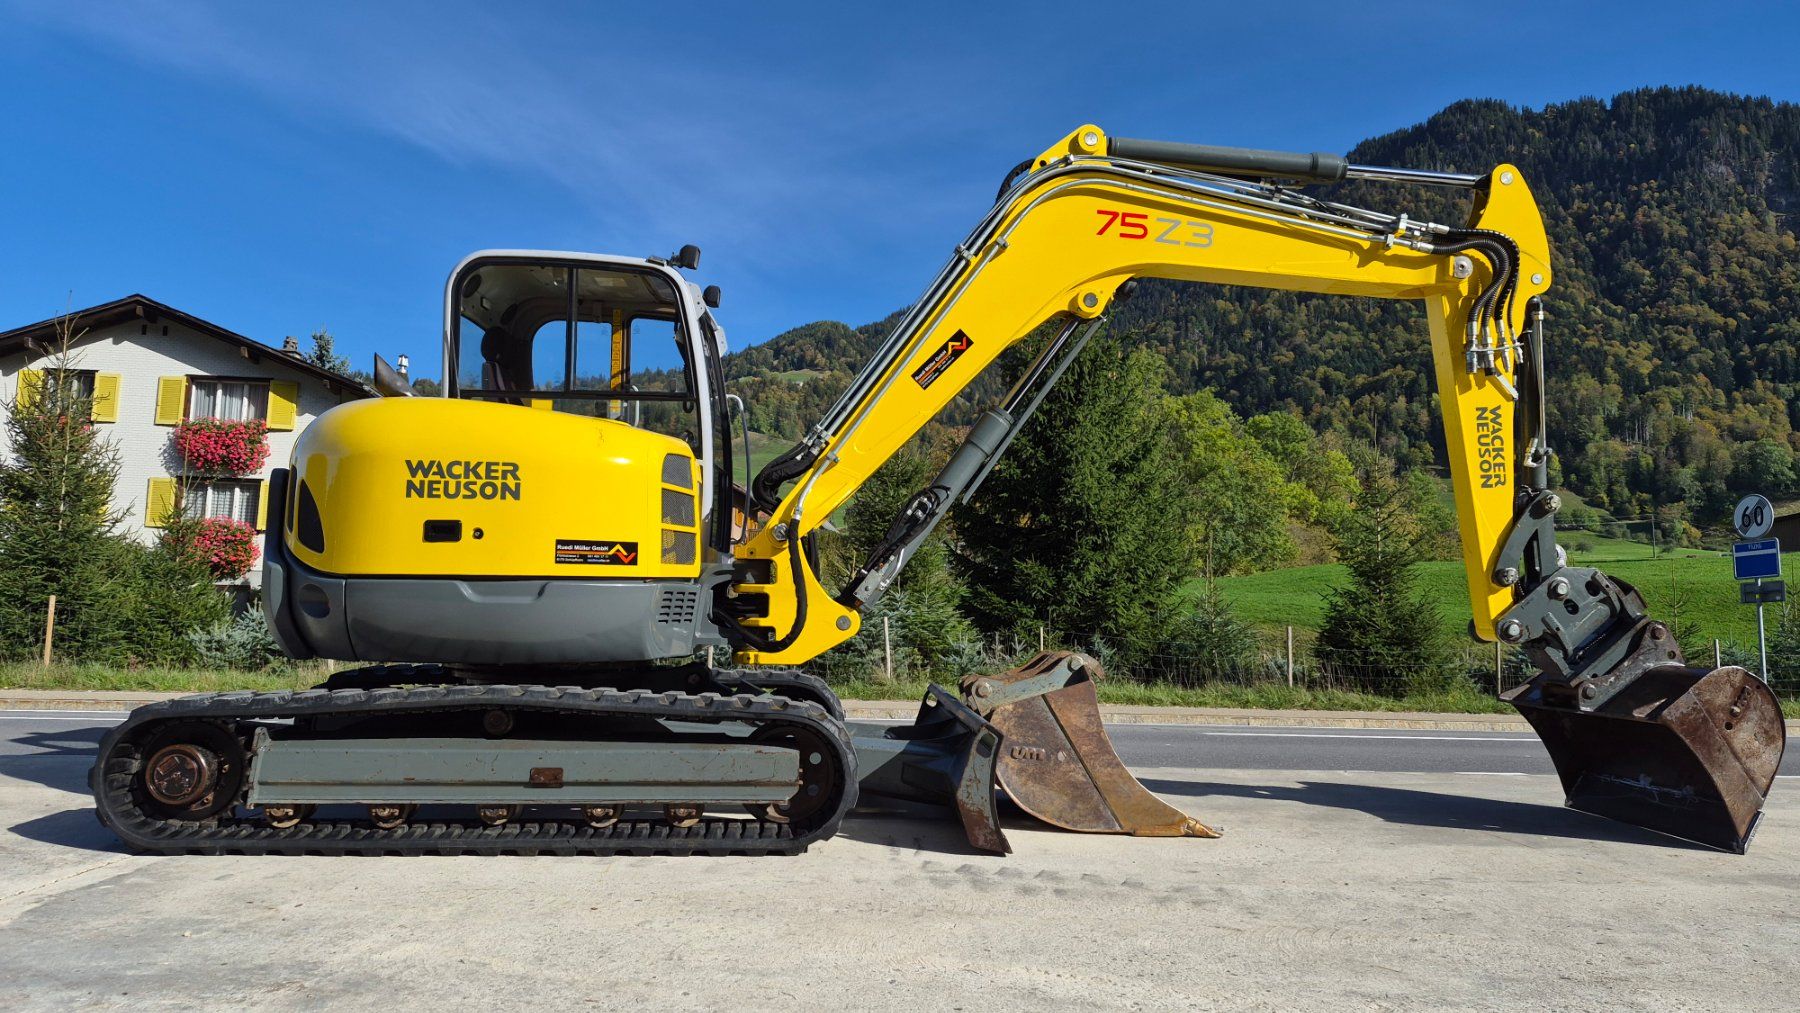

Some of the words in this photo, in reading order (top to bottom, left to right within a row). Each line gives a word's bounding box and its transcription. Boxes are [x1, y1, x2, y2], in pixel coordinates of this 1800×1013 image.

[1475, 406, 1494, 489] NEUSON
[1489, 404, 1507, 488] WACKER
[404, 459, 521, 481] WACKER
[405, 479, 521, 501] NEUSON
[1741, 505, 1764, 528] 60
